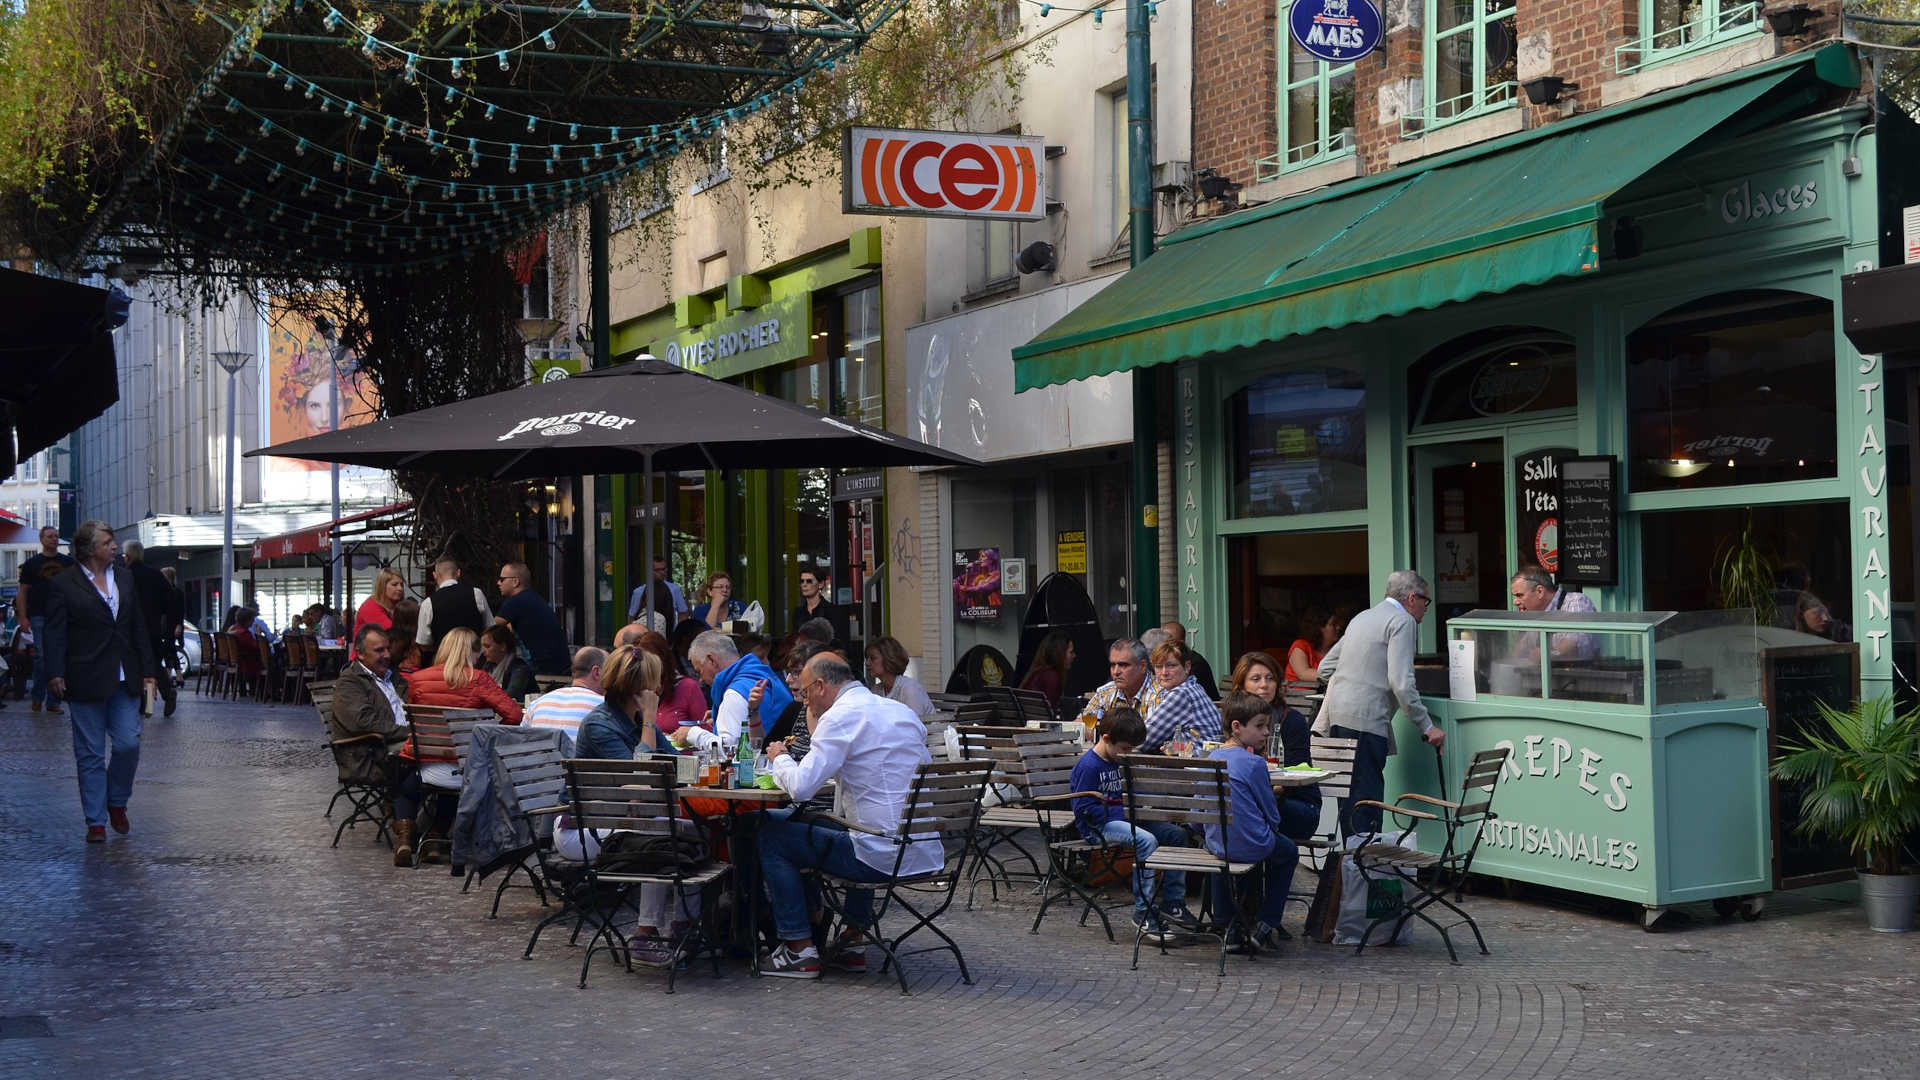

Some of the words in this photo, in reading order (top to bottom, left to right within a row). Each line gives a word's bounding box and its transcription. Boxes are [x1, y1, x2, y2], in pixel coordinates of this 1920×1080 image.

[1305, 24, 1364, 48] MAES
[1721, 180, 1817, 224] Glaces
[682, 338, 716, 369] YVES
[718, 319, 780, 359] ROCHER
[846, 476, 880, 490] L'INSTITUT
[1477, 818, 1639, 871] ARTISANALES
